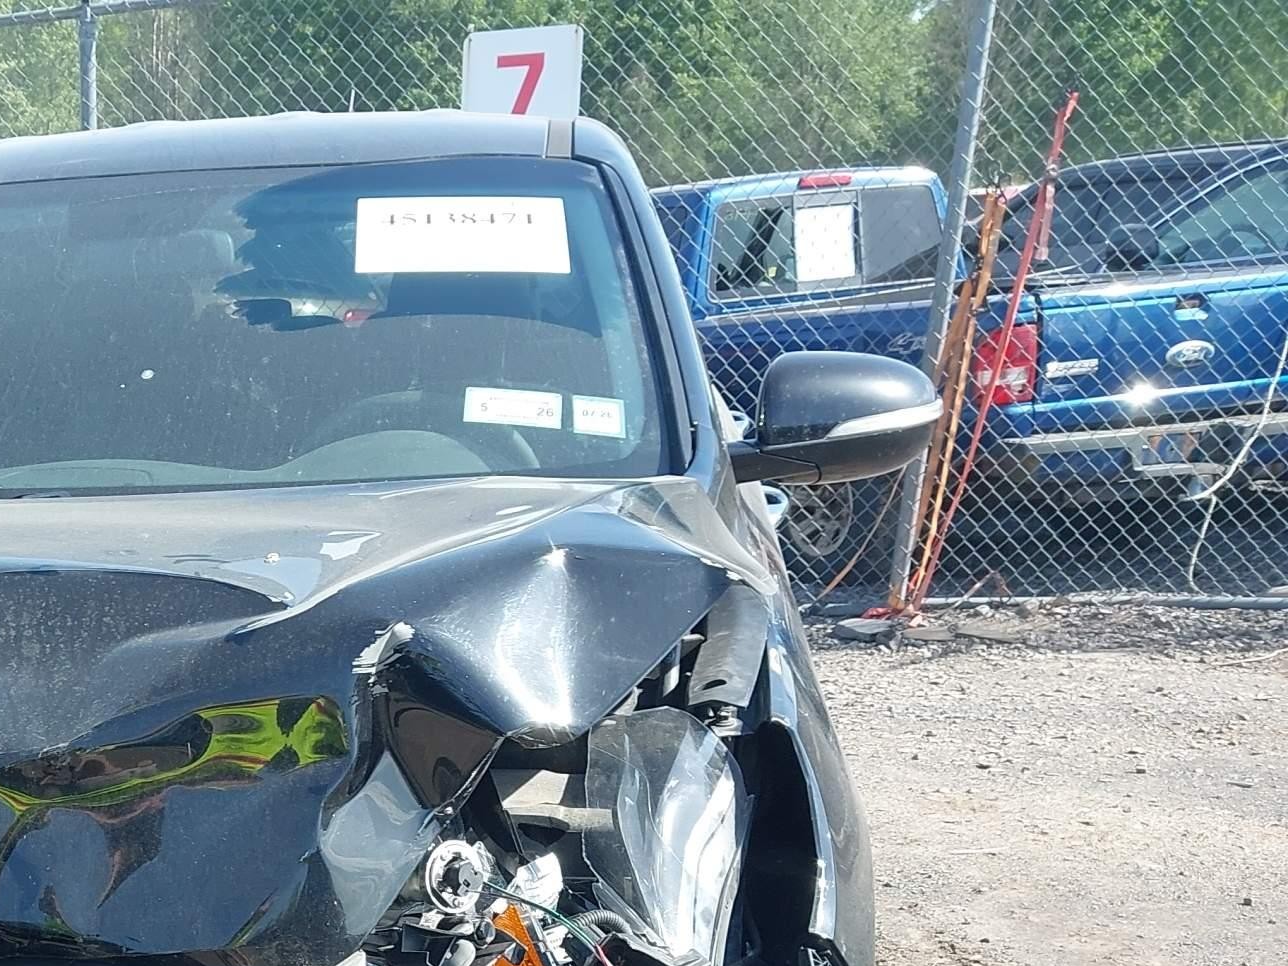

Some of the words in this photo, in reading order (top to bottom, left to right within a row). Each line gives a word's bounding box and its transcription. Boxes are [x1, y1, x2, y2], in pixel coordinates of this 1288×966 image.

[496, 52, 545, 115] 7
[381, 211, 533, 226] 45138471
[536, 407, 554, 417] 26
